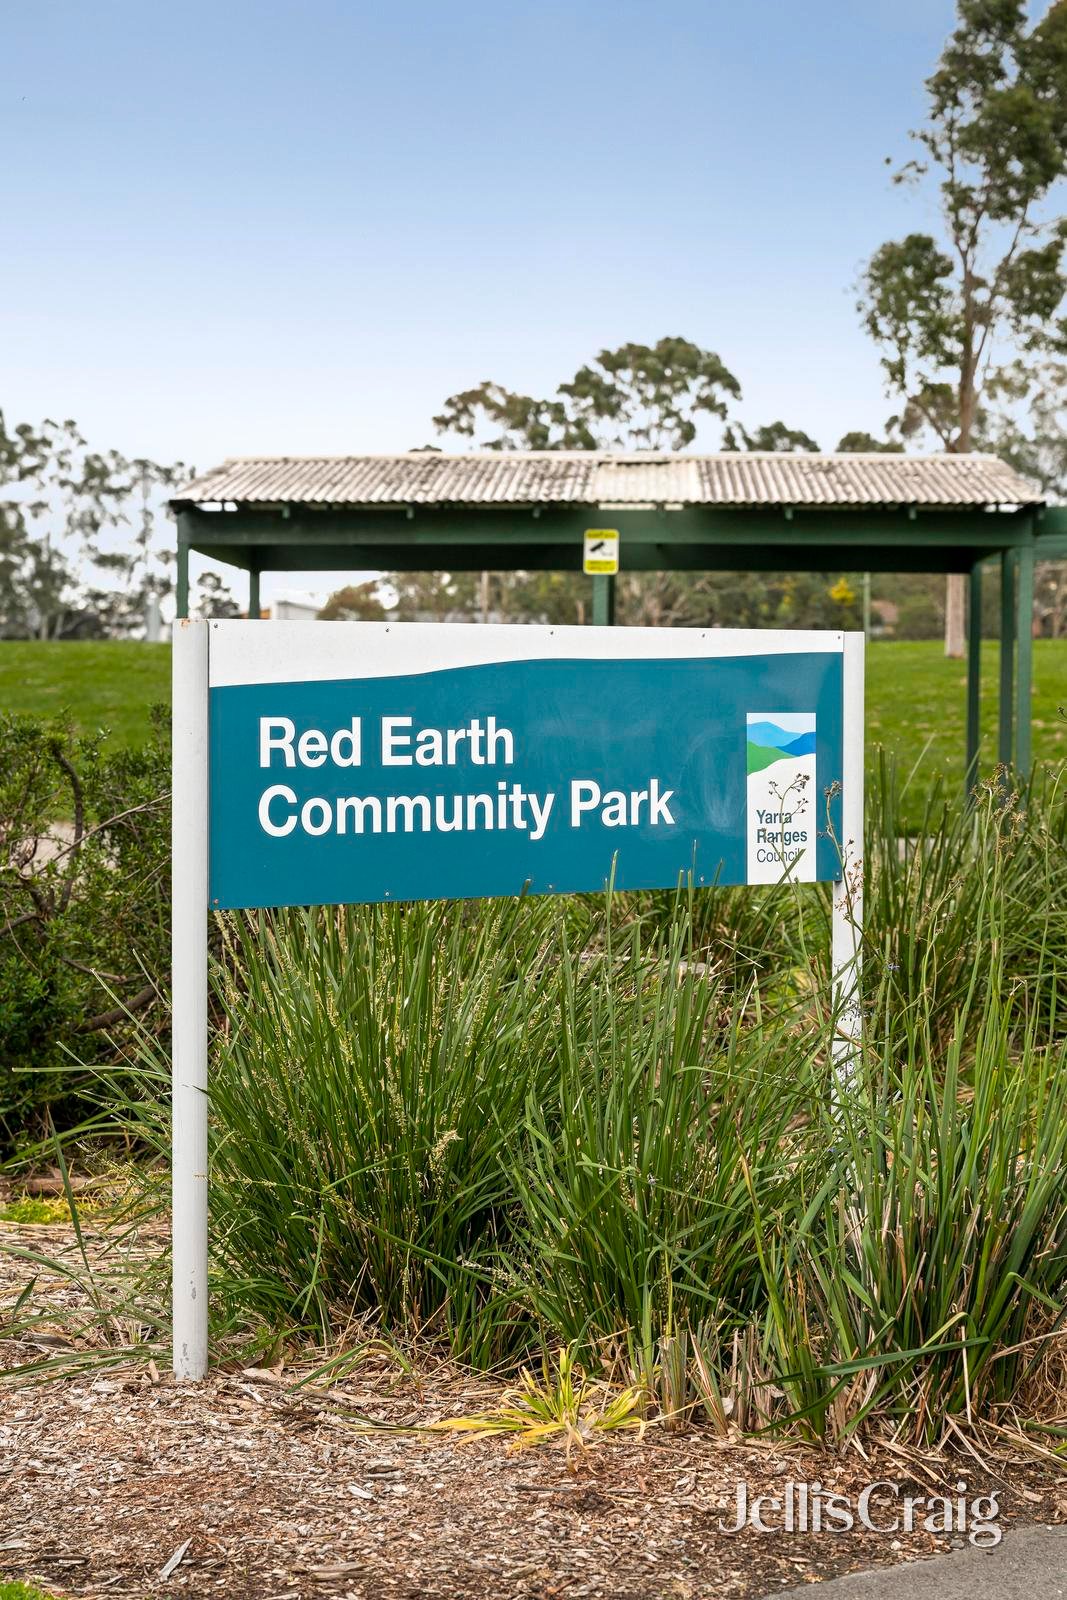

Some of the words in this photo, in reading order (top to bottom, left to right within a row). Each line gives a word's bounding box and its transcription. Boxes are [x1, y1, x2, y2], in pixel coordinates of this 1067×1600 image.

[259, 716, 361, 768] Red
[381, 716, 514, 766] Earth
[258, 781, 555, 840] Community
[571, 778, 675, 827] Park
[756, 809, 792, 824] Yarra
[757, 829, 808, 846] Ranges
